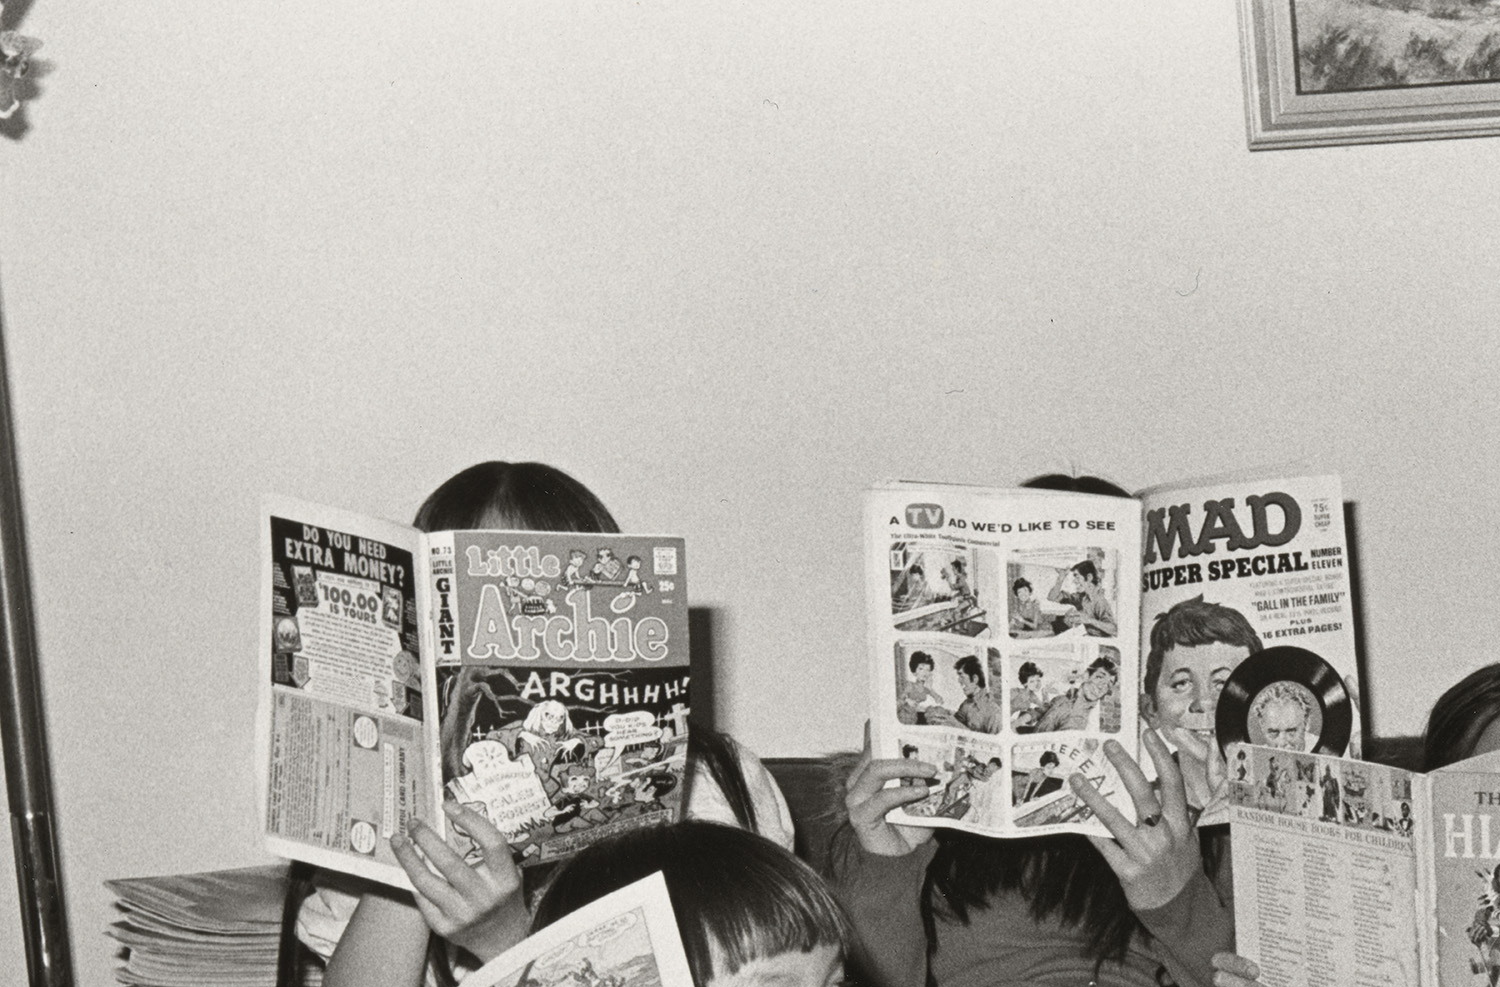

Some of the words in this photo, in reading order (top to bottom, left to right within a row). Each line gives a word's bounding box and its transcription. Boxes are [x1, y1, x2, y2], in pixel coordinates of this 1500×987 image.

[889, 516, 900, 525] A
[907, 508, 942, 525] TV
[949, 518, 967, 529] AD
[971, 521, 1012, 533] WE'D
[1018, 521, 1052, 532] LIKE
[1058, 519, 1080, 530] TO
[1086, 520, 1116, 531] SEE
[1144, 491, 1302, 566] MAD
[303, 524, 320, 543] DO
[326, 530, 351, 551] YOU
[358, 538, 387, 560] NEED
[1310, 547, 1342, 558] NUMBER
[284, 537, 335, 568] EXTRA
[344, 551, 405, 587] MONEY?
[466, 545, 560, 578] Little
[1142, 563, 1203, 592] SUPER
[1208, 552, 1308, 581] SPECIAL
[1311, 558, 1343, 570] ELEVEN
[318, 581, 379, 612] $100.00
[329, 603, 340, 615] IS
[1280, 598, 1290, 609] IN
[1291, 595, 1307, 608] THE
[1309, 592, 1345, 606] FAMILY"
[343, 607, 377, 624] YOURS
[436, 577, 455, 654] GIANT
[467, 584, 668, 661] Archie
[1262, 631, 1273, 639] 16
[1275, 625, 1307, 638] EXTRA
[1308, 622, 1343, 634] PAGES!
[521, 670, 690, 705] ARGHHHH!
[1237, 809, 1275, 824] RANDOM
[1278, 818, 1308, 832] HOUSE
[1311, 823, 1342, 839] BOOKS
[1344, 830, 1363, 843] FOR
[1364, 833, 1414, 851] CHILDREN
